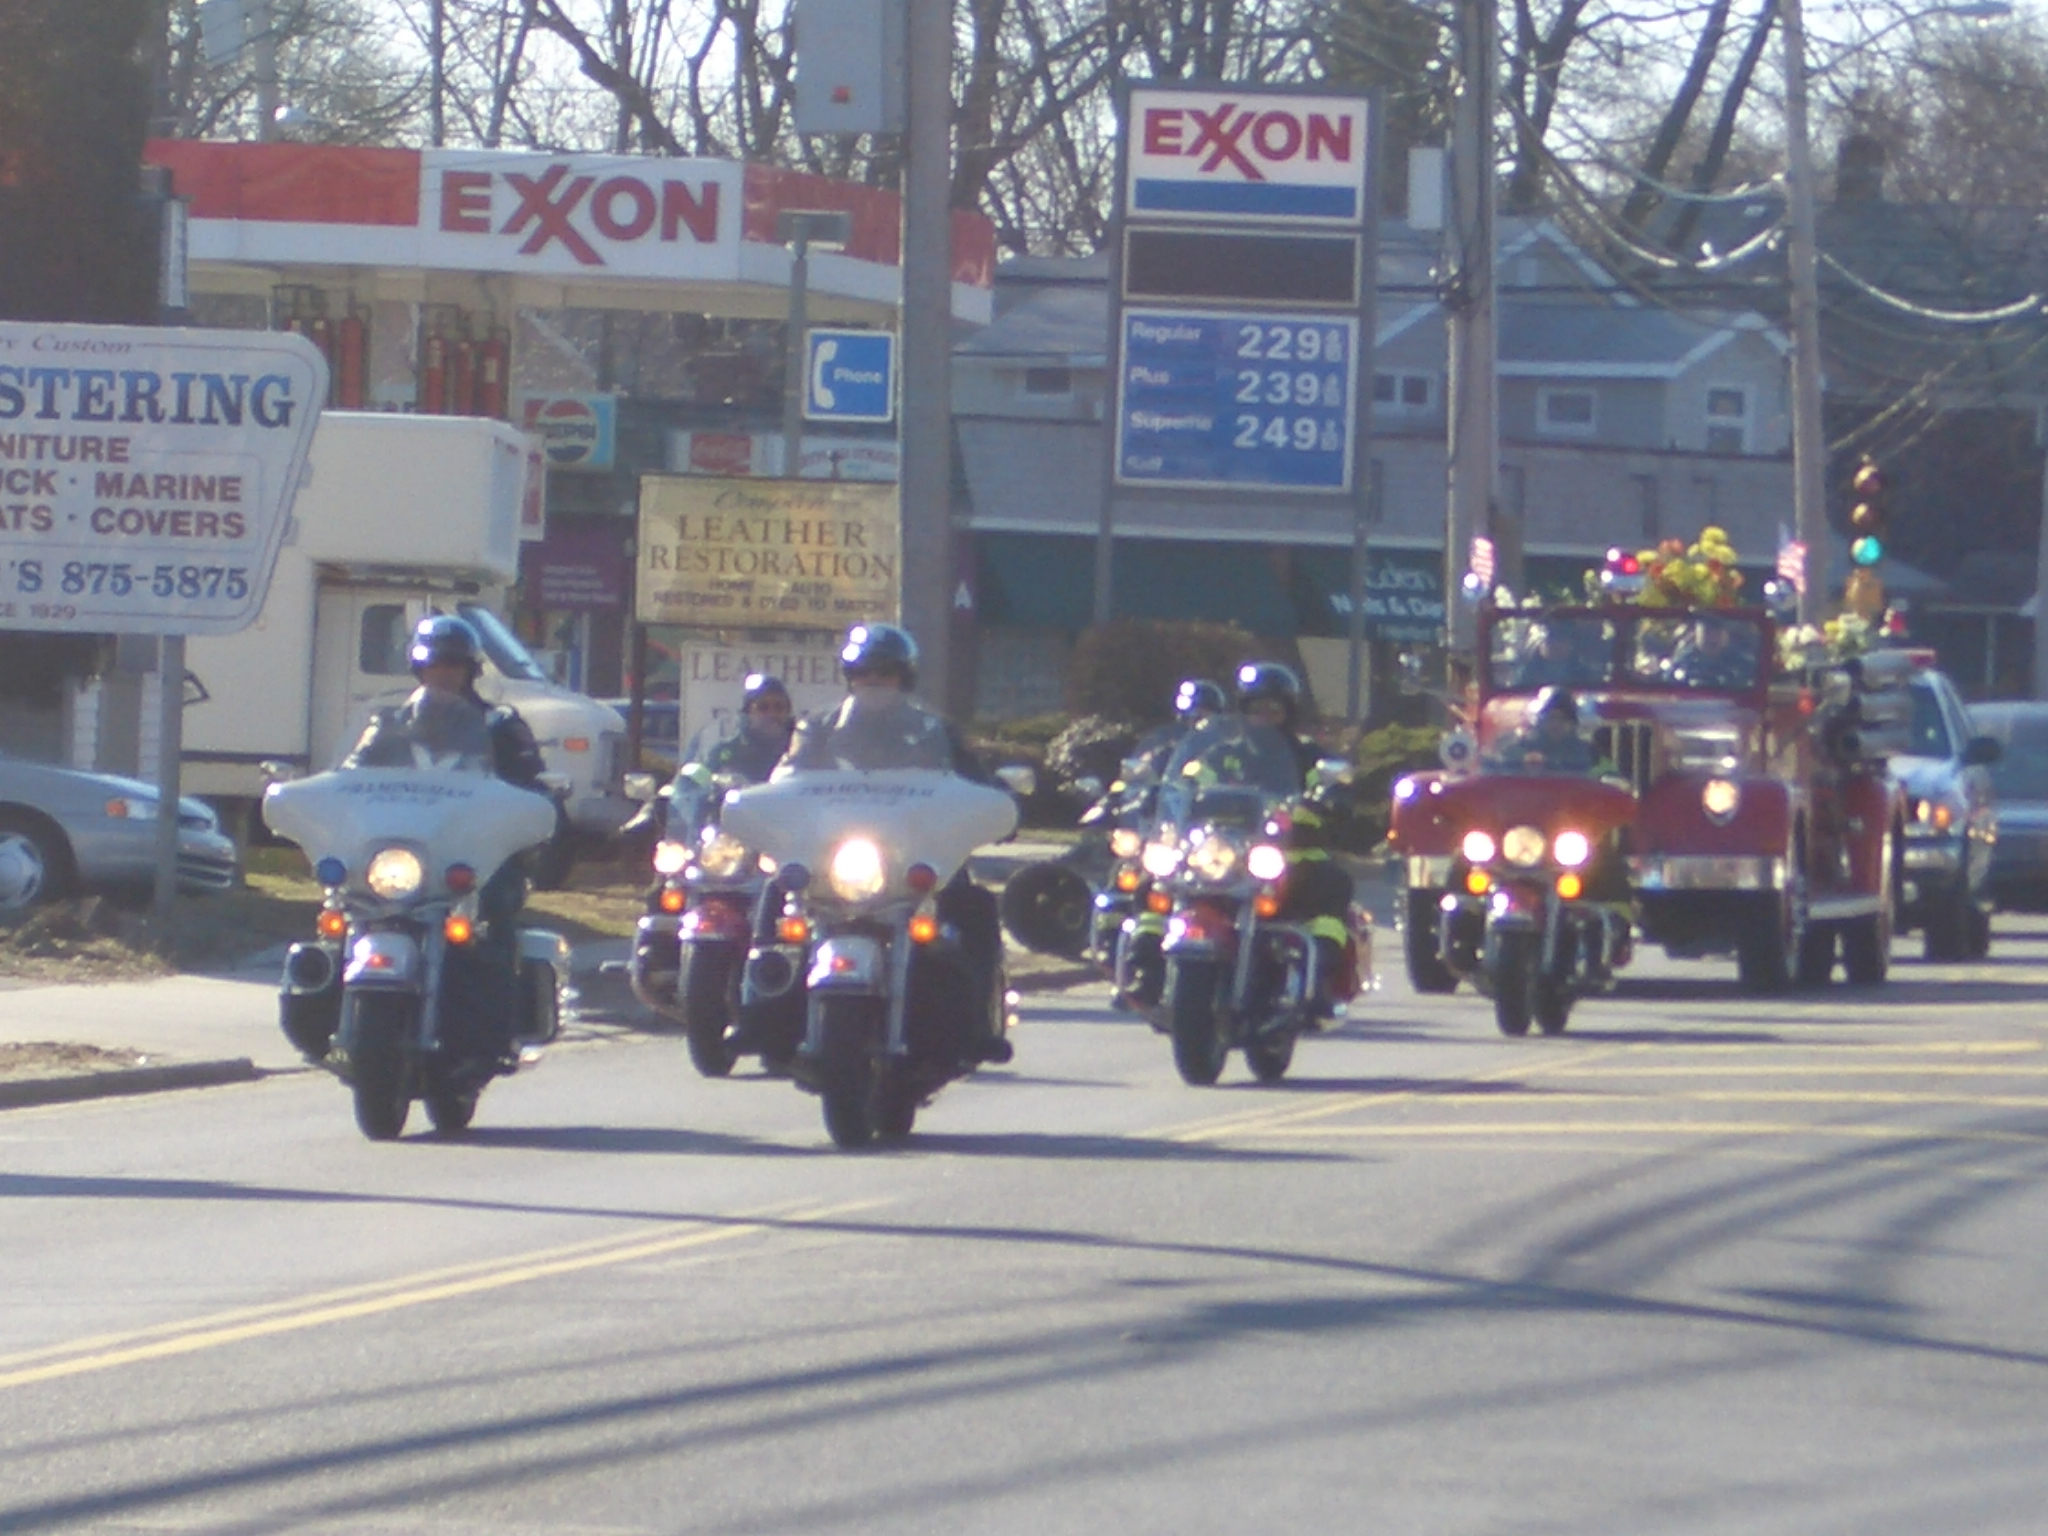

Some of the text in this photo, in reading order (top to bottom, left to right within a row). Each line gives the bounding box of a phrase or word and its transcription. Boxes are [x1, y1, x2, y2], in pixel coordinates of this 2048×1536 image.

[1143, 103, 1352, 181] EXXON
[439, 164, 720, 265] EXXON
[32, 334, 132, 353] Custom
[1131, 321, 1201, 344] Regular
[833, 367, 883, 384] Phone
[1130, 366, 1170, 385] Plus
[1130, 411, 1213, 433] Supreme
[0, 469, 242, 502] CK MARINE
[90, 507, 246, 539] COVERS
[678, 514, 867, 547] LEATHER
[650, 546, 895, 579] RESTORATION
[61, 560, 248, 600] 875-5875
